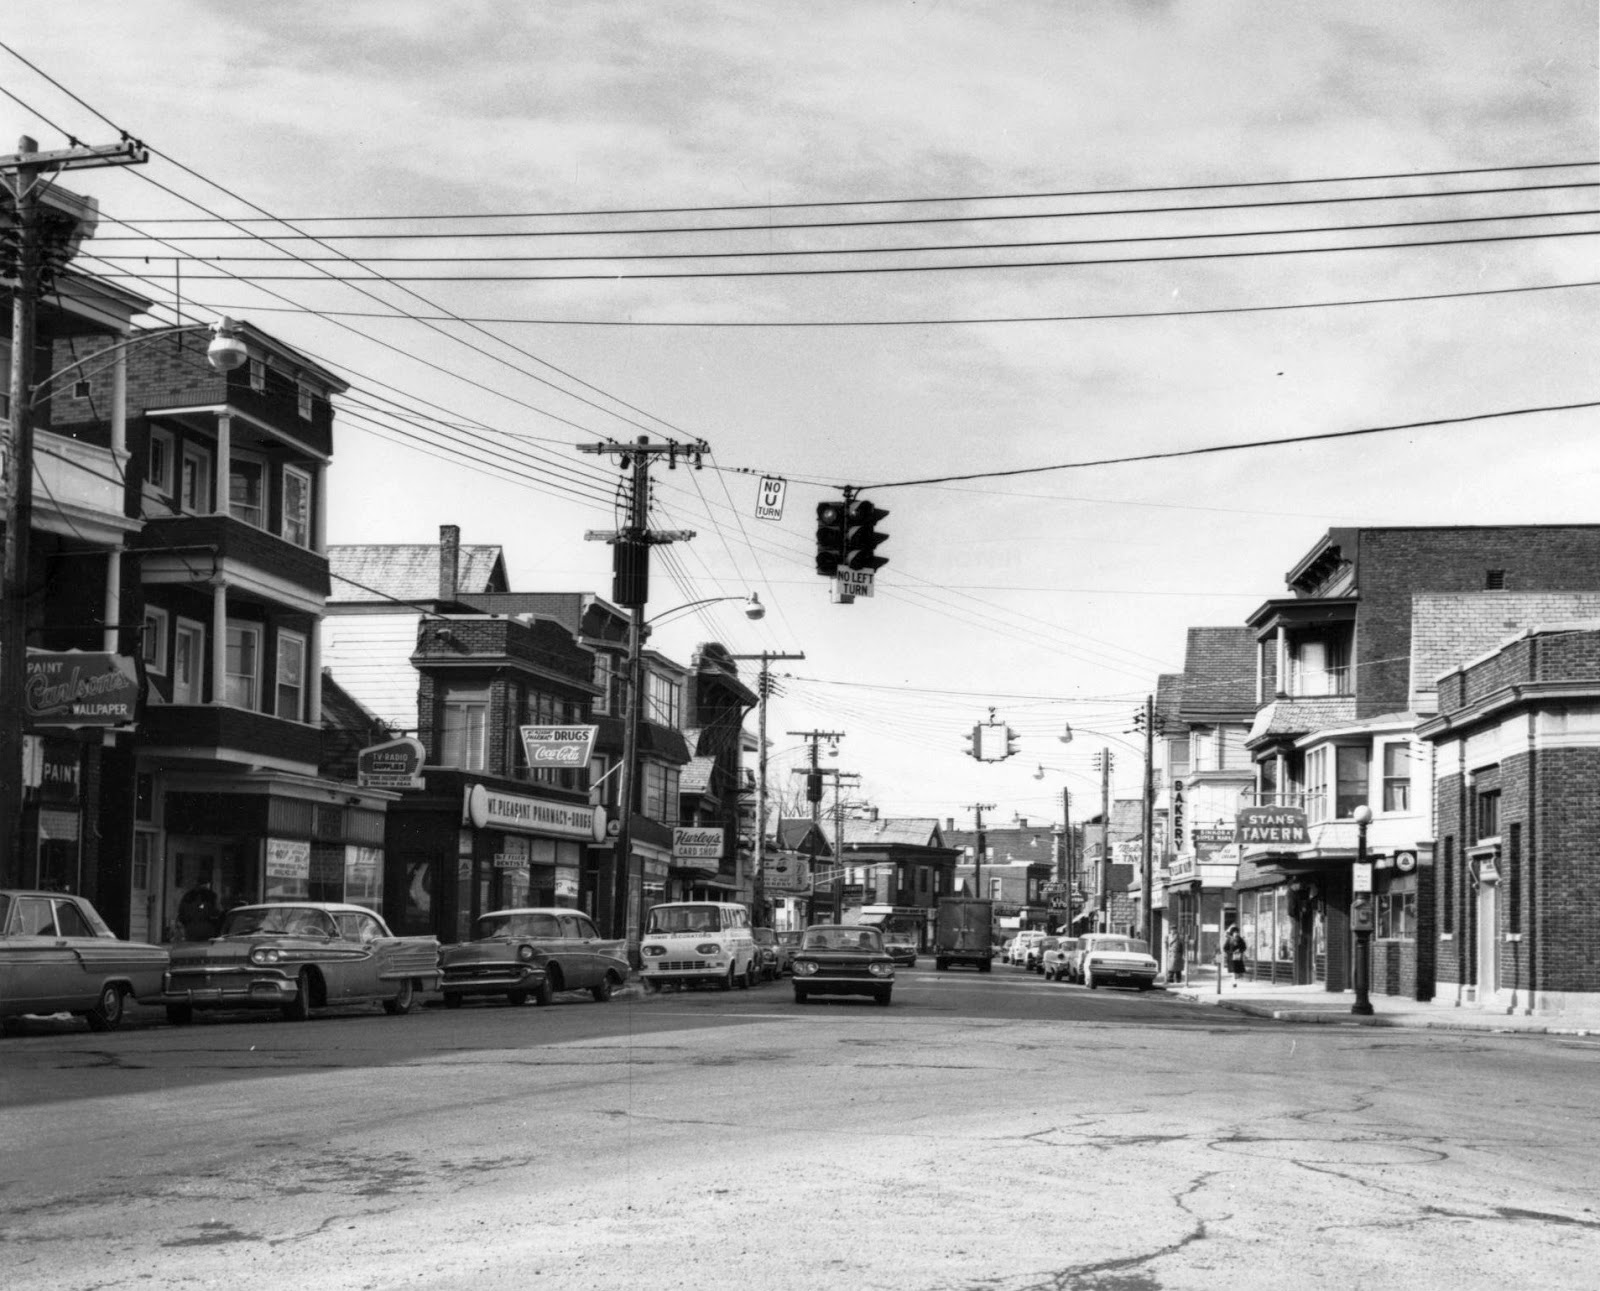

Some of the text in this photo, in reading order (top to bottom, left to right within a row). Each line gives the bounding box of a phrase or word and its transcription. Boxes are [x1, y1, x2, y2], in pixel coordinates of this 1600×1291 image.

[764, 481, 781, 493] NO
[765, 494, 777, 506] U
[758, 506, 781, 517] TURN
[837, 571, 874, 584] NO LEFT
[844, 583, 868, 596] TURN
[26, 662, 63, 673] PAINT
[72, 704, 128, 715] WALLPAPER
[554, 730, 589, 741] DRUGS
[535, 745, 580, 761] Coca-Cola
[43, 762, 80, 783] PAINT
[498, 800, 530, 819] PLEASANT
[1174, 780, 1184, 851] BAKERY
[1249, 814, 1295, 824] STAN'S
[675, 830, 721, 848] Hurley's
[1241, 827, 1304, 840] TAVERN
[679, 847, 718, 856] CARD SHOP
